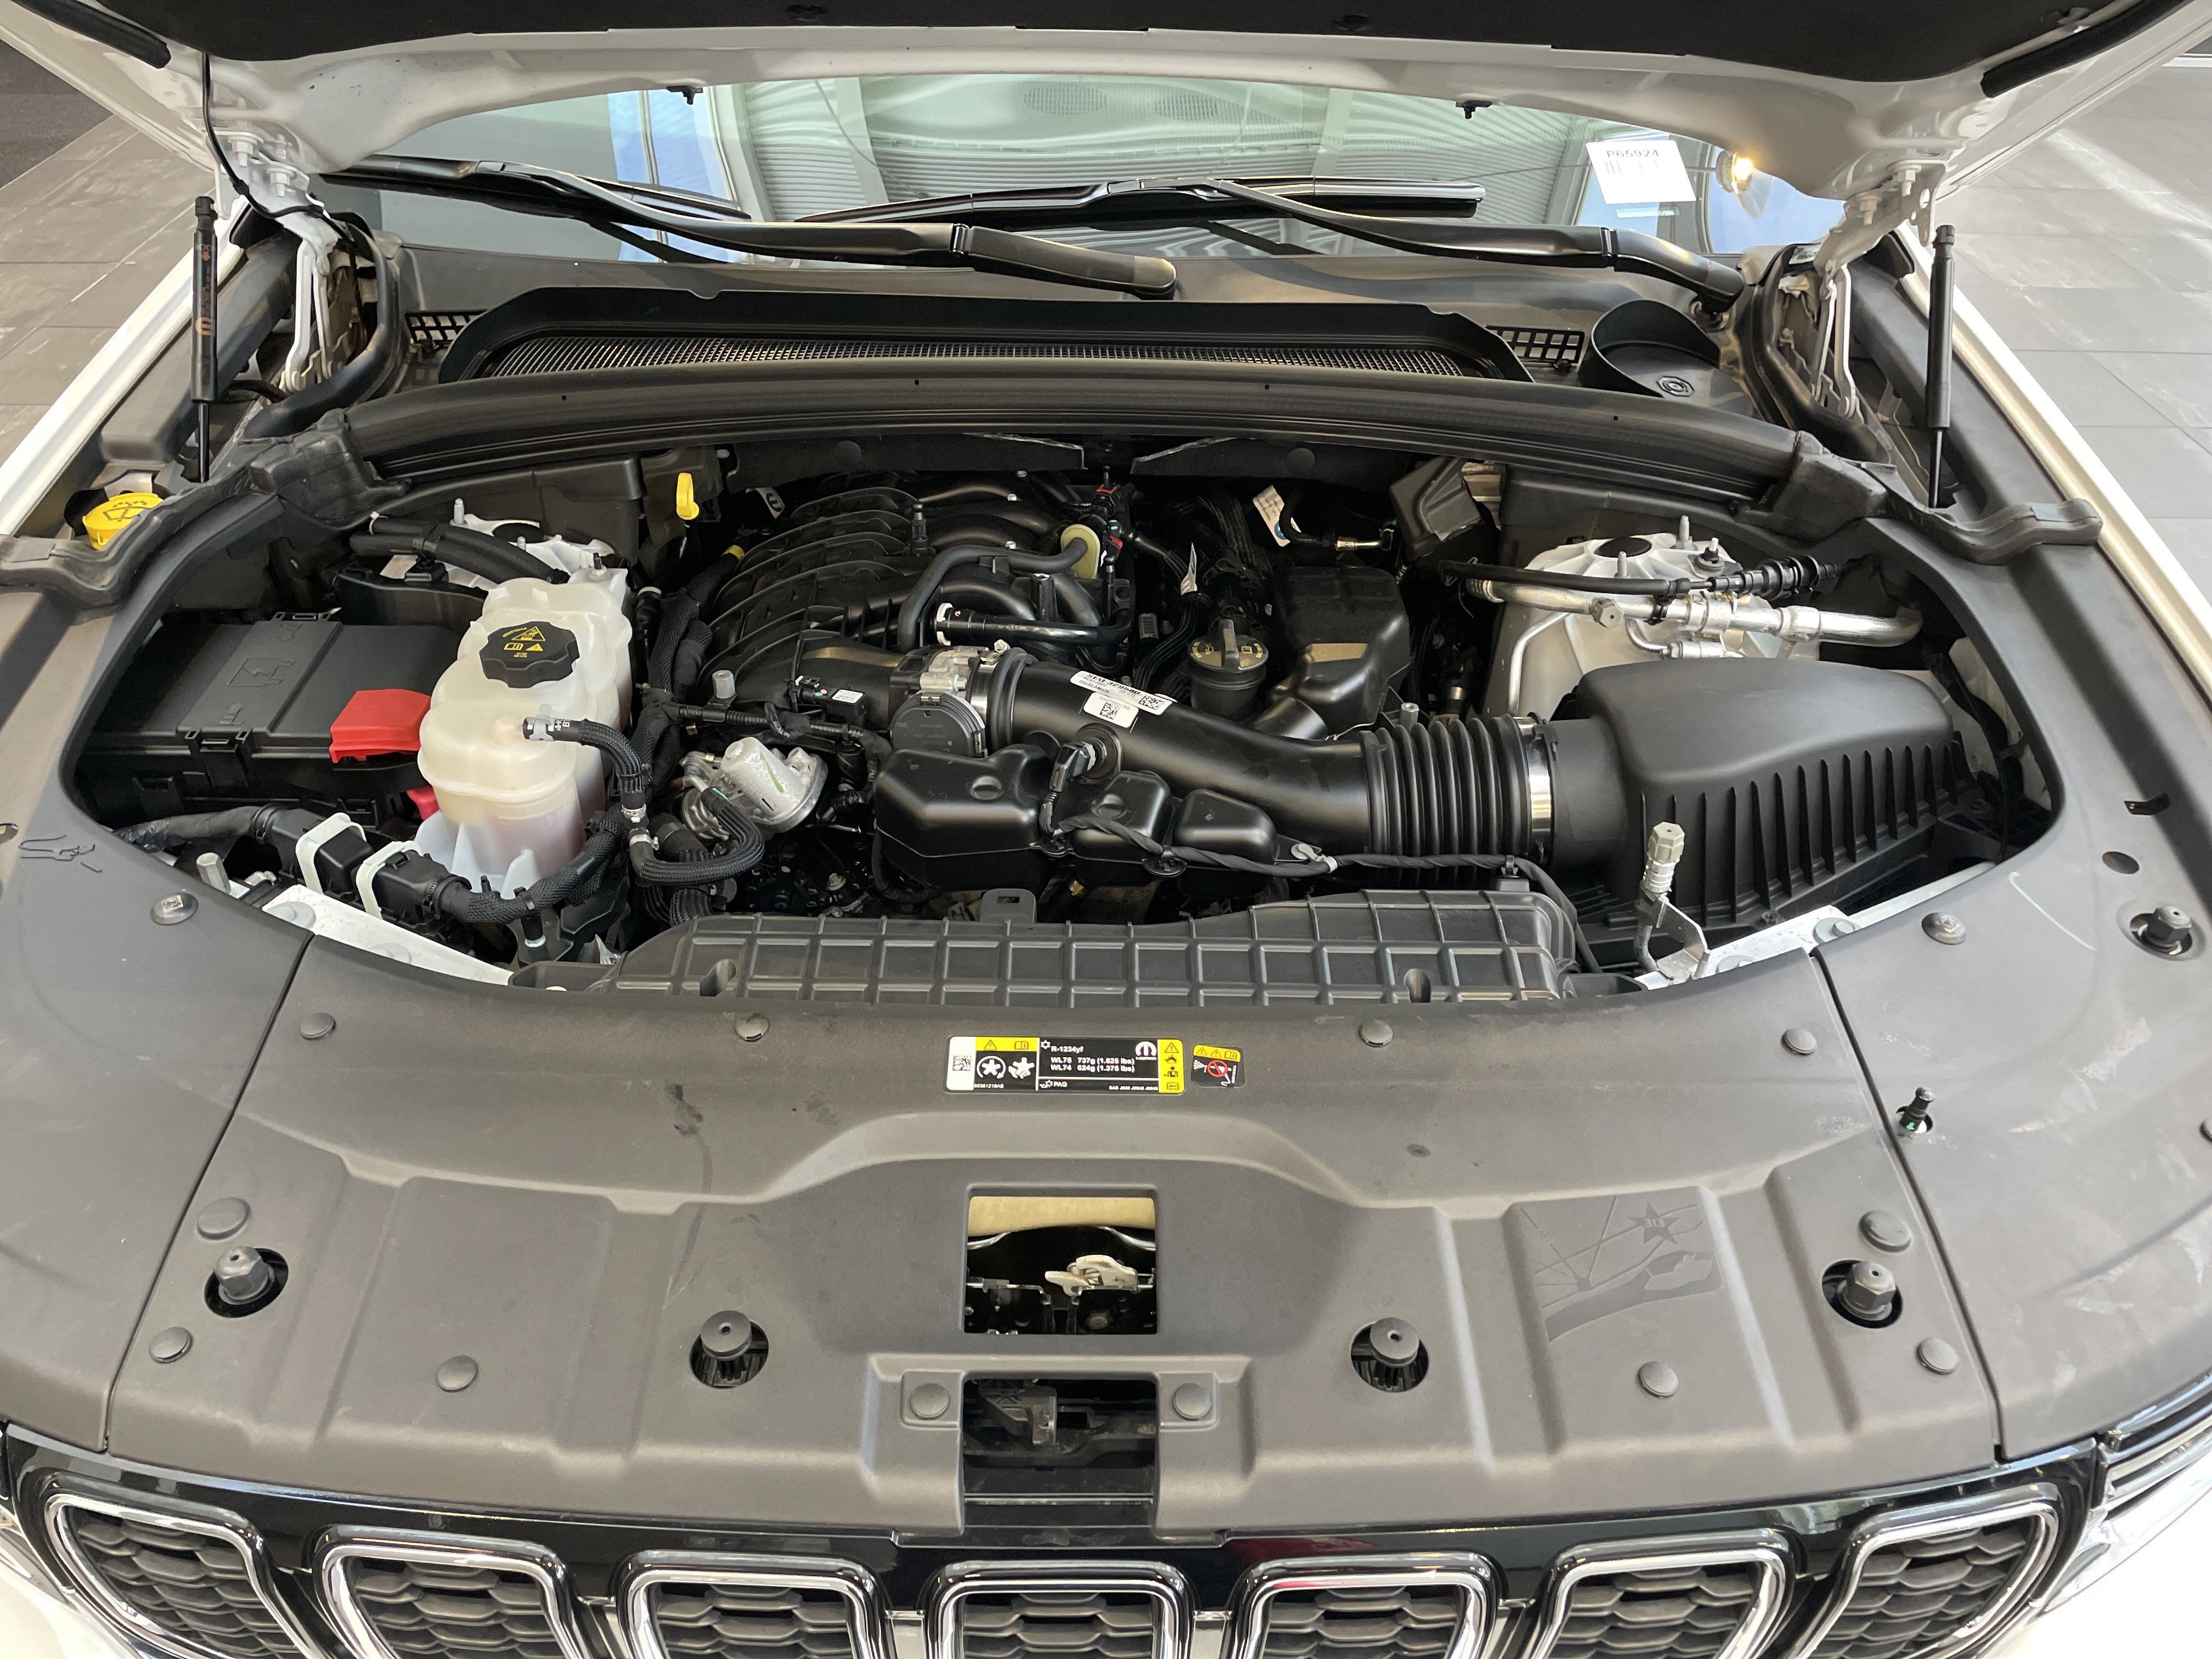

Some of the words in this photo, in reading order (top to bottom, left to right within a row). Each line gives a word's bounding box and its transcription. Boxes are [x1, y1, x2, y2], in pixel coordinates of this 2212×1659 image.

[1607, 149, 1659, 158] P65924
[1051, 1046, 1084, 1054] R-1234yf
[1077, 1057, 1096, 1065] 737g
[1077, 1064, 1096, 1073] 624g
[1120, 1065, 1135, 1073] lbs)
[1644, 1218, 1666, 1228] 313
